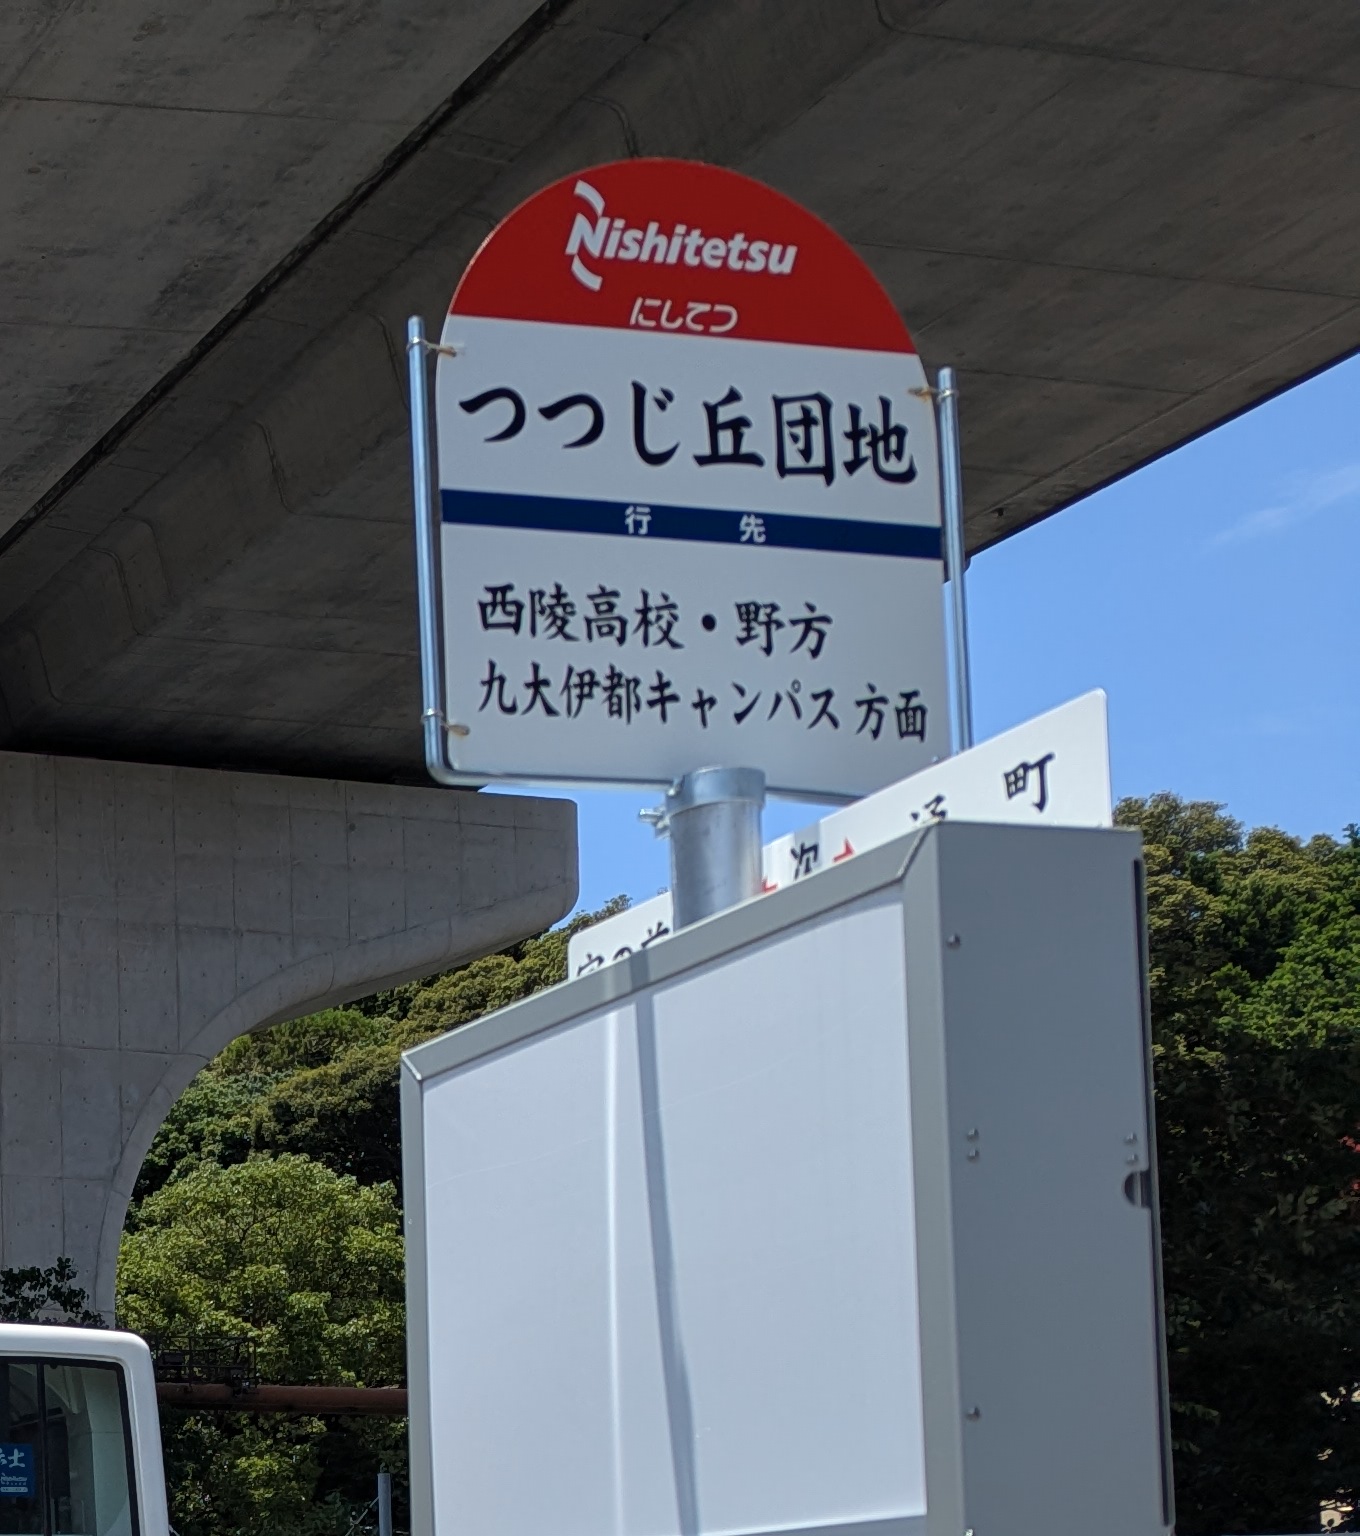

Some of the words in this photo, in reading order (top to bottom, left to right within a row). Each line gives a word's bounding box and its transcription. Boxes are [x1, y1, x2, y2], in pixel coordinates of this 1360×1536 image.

[567, 213, 797, 276] Nishitetsu
[630, 297, 738, 333] にしてつ
[459, 380, 917, 488] つつじ丘団地
[477, 582, 833, 659] 西陵高校・野方
